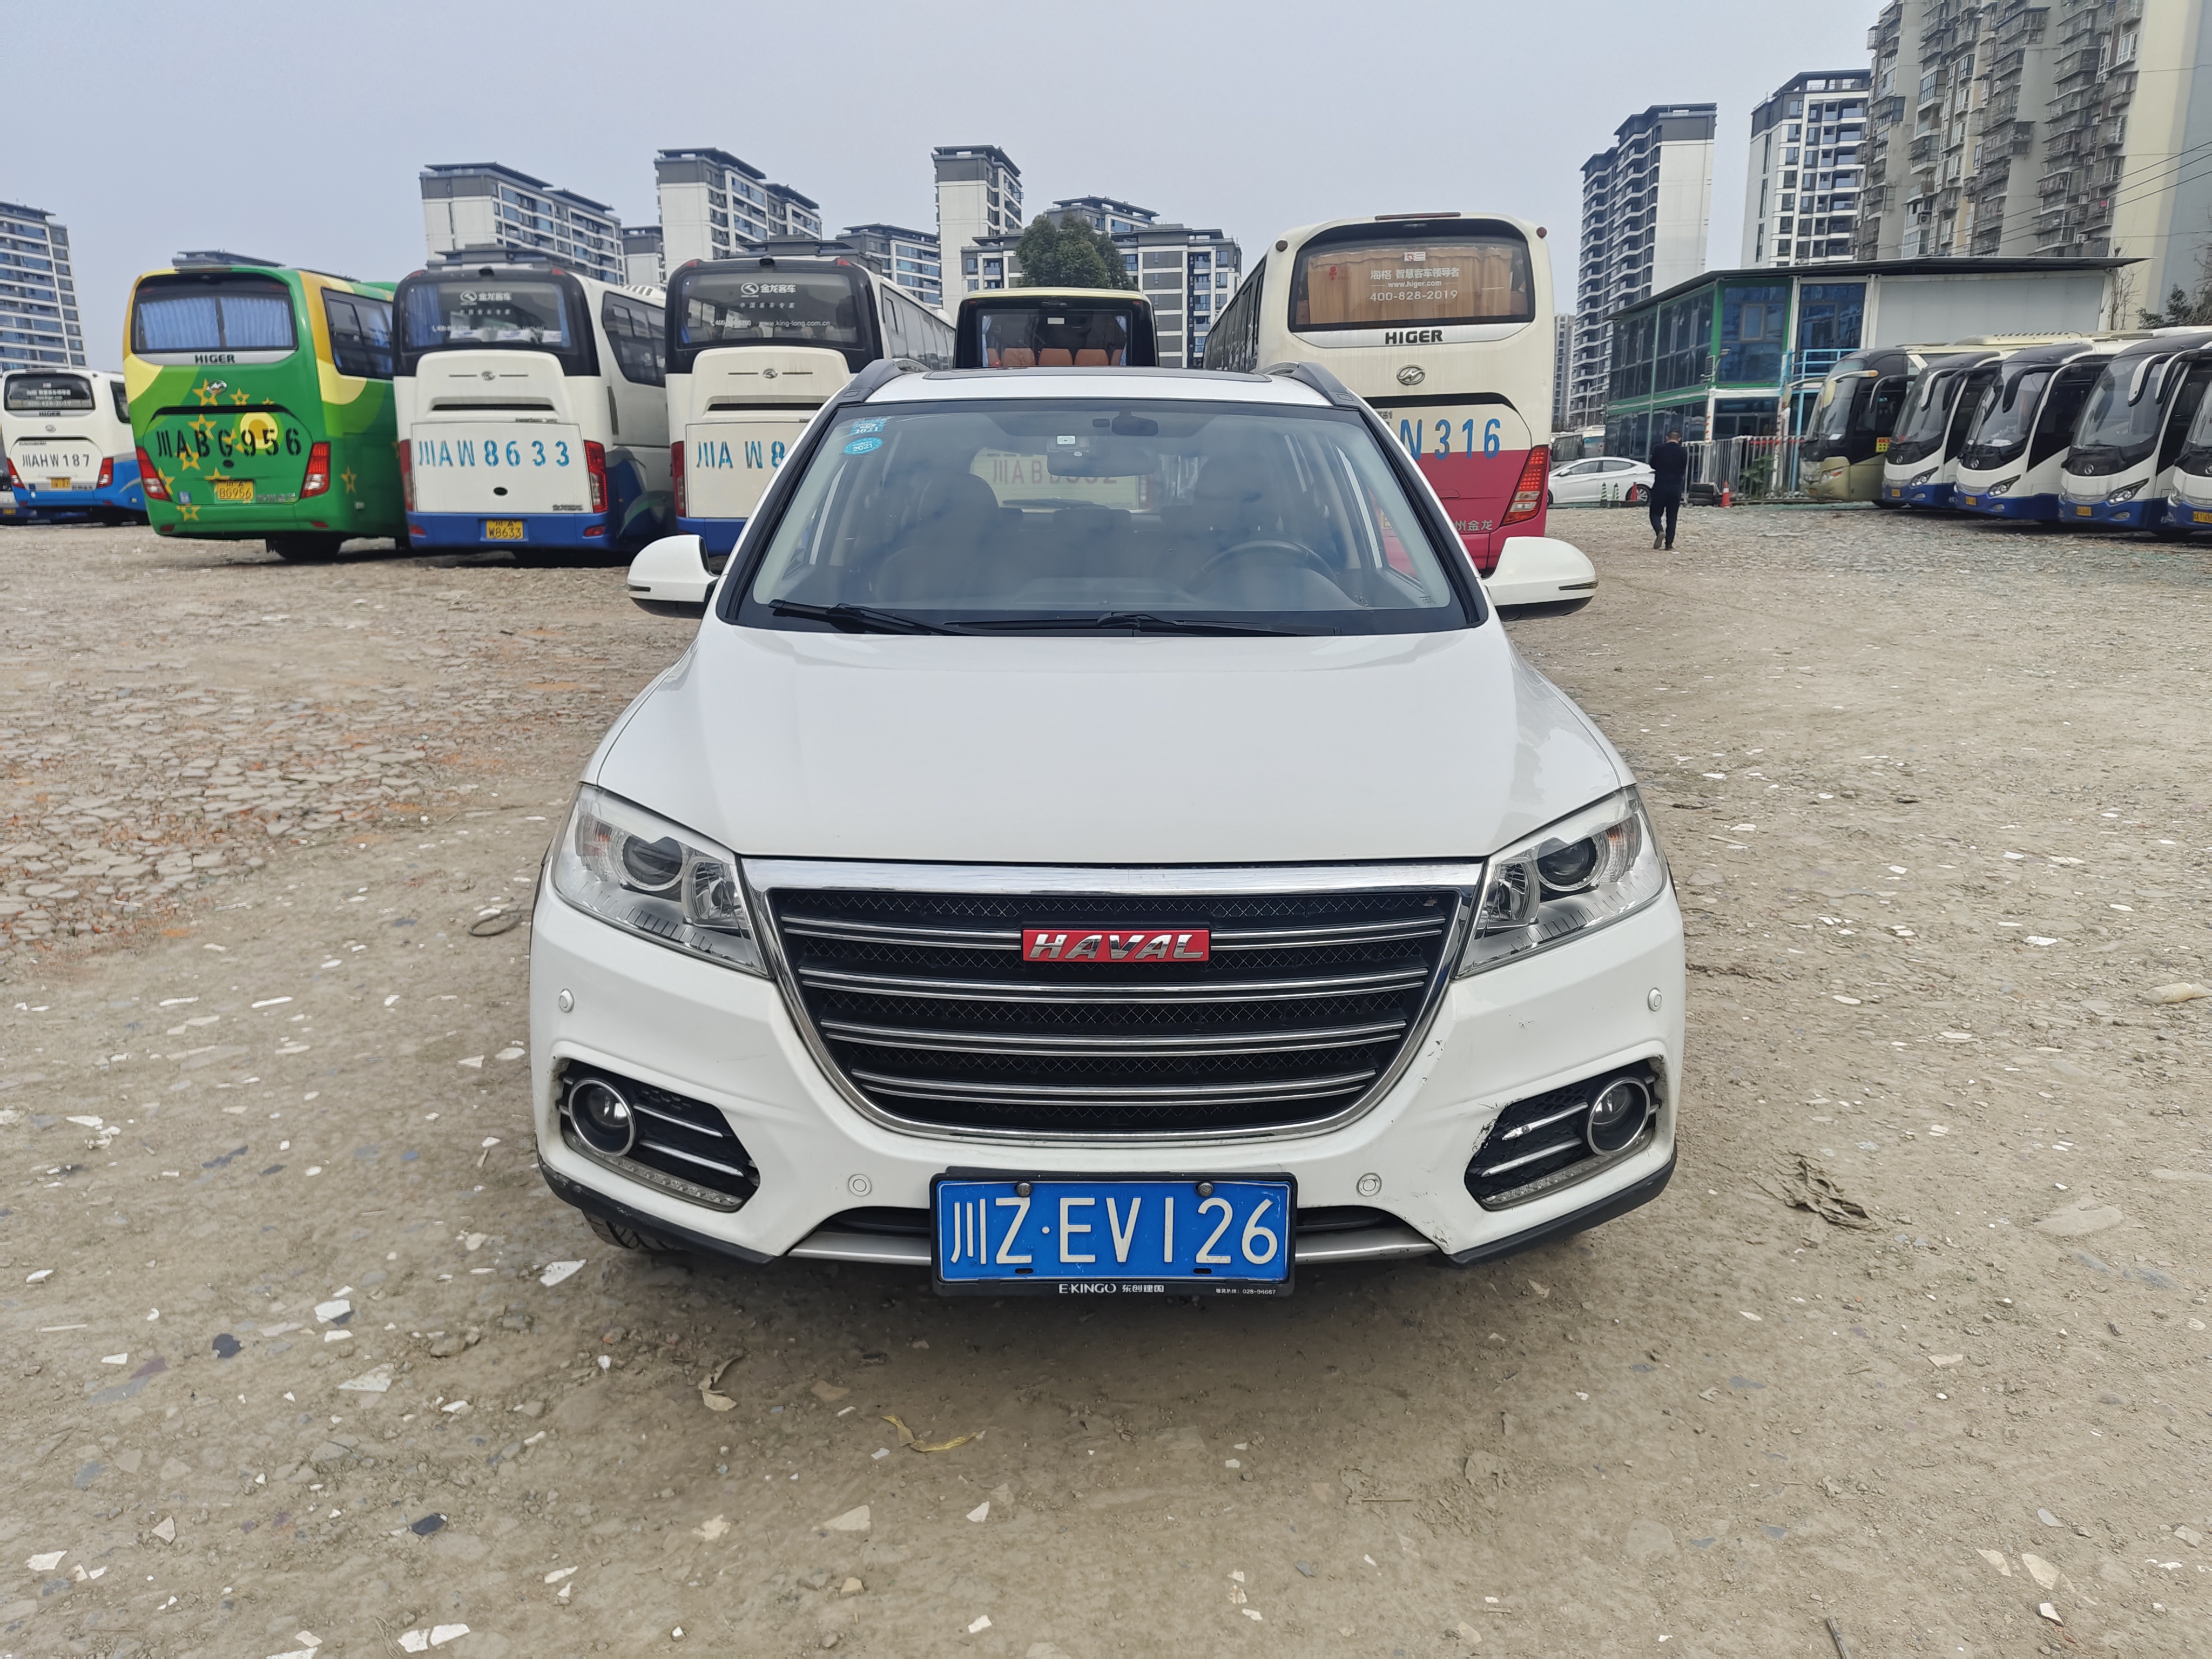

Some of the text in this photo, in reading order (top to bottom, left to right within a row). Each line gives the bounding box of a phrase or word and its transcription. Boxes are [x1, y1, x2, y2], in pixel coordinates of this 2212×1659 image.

[1370, 267, 1460, 280] 海格 智慧客车领导者
[760, 284, 797, 293] 金龙客车
[1387, 280, 1442, 288] www.higer.com
[1370, 290, 1458, 301] 400-828-2019
[1385, 329, 1444, 345] HIGER
[194, 354, 236, 364] HIGER
[1386, 418, 1501, 461] N316
[852, 443, 873, 452] 2021
[219, 488, 252, 500] BG956
[1454, 520, 1493, 531] 州金龙
[489, 527, 522, 538] W8633
[1028, 933, 1204, 959] HAVAL
[1122, 1284, 1164, 1292] 东创建国
